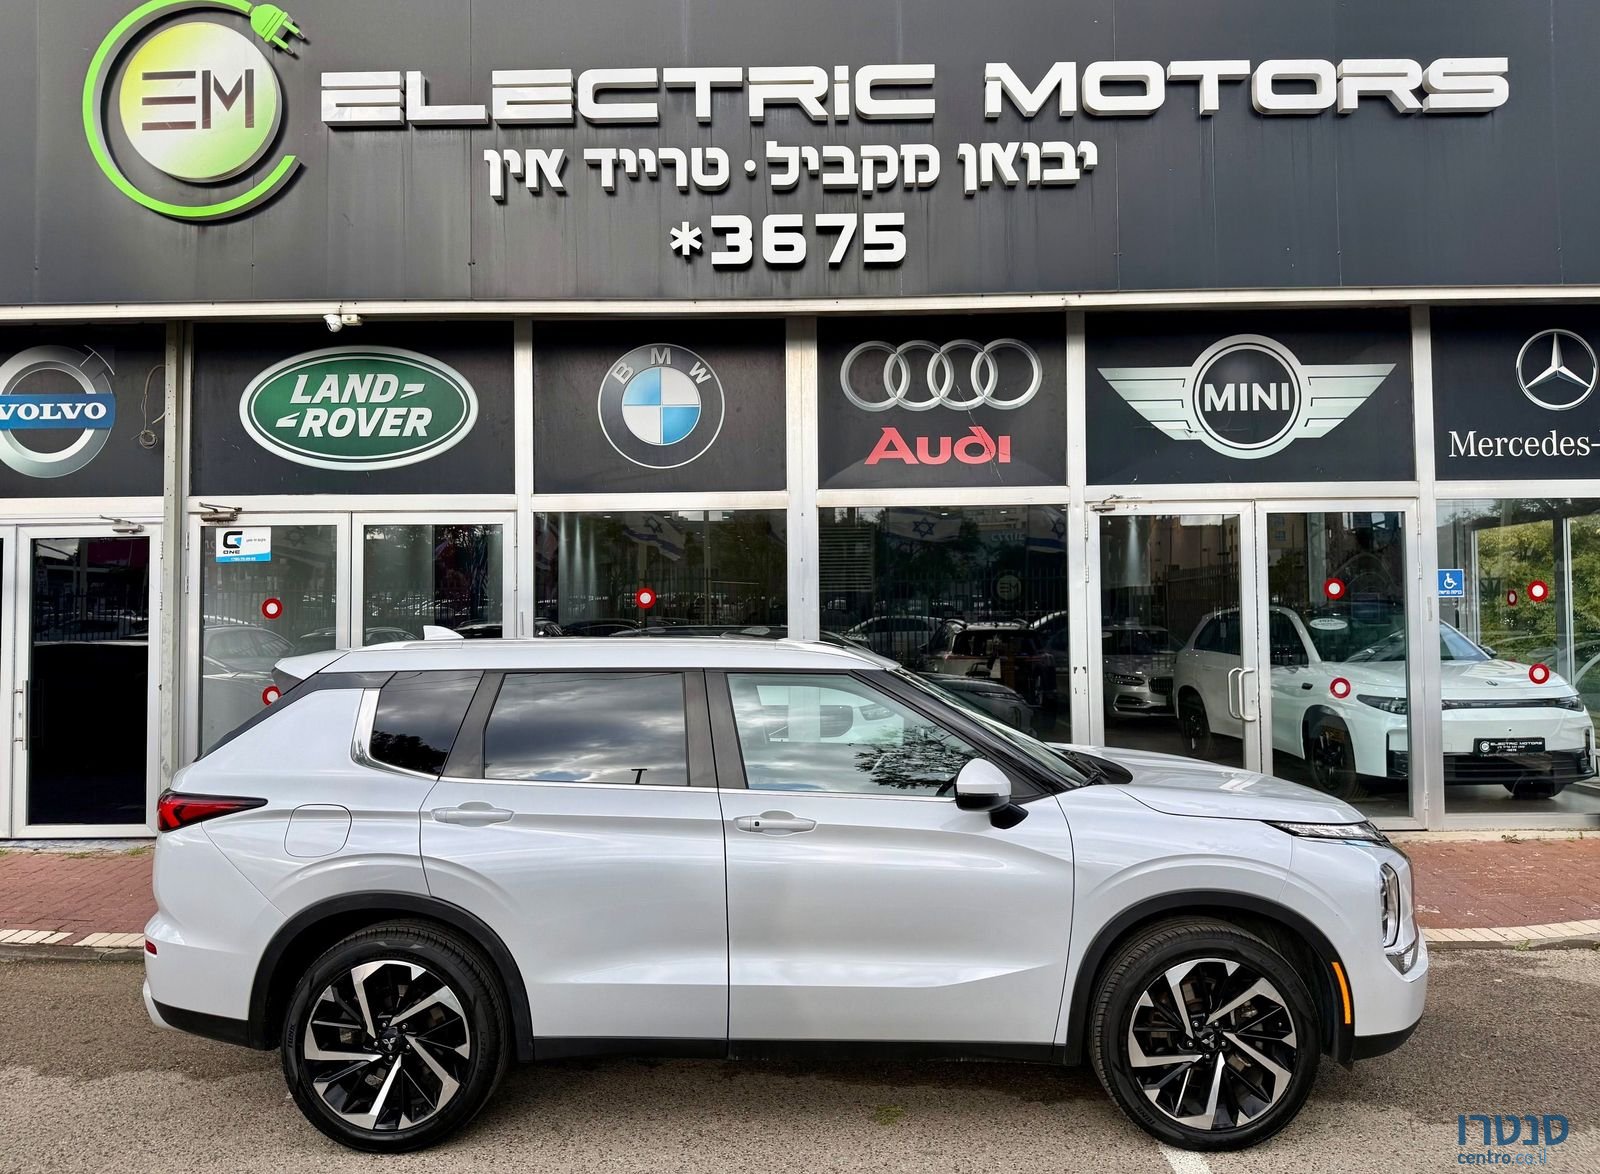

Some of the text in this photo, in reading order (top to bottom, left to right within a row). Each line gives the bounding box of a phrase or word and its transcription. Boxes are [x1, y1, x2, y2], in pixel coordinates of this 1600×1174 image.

[141, 68, 255, 131] EM
[321, 57, 1510, 127] ELECTRIC MOTORS
[484, 140, 1098, 200] יבואן מקביל טרייד אין
[289, 373, 399, 404] LAND
[1203, 382, 1290, 412] MINI
[0, 402, 107, 421] VOLVO
[298, 407, 433, 438] ROVER
[864, 426, 1012, 465] Audi
